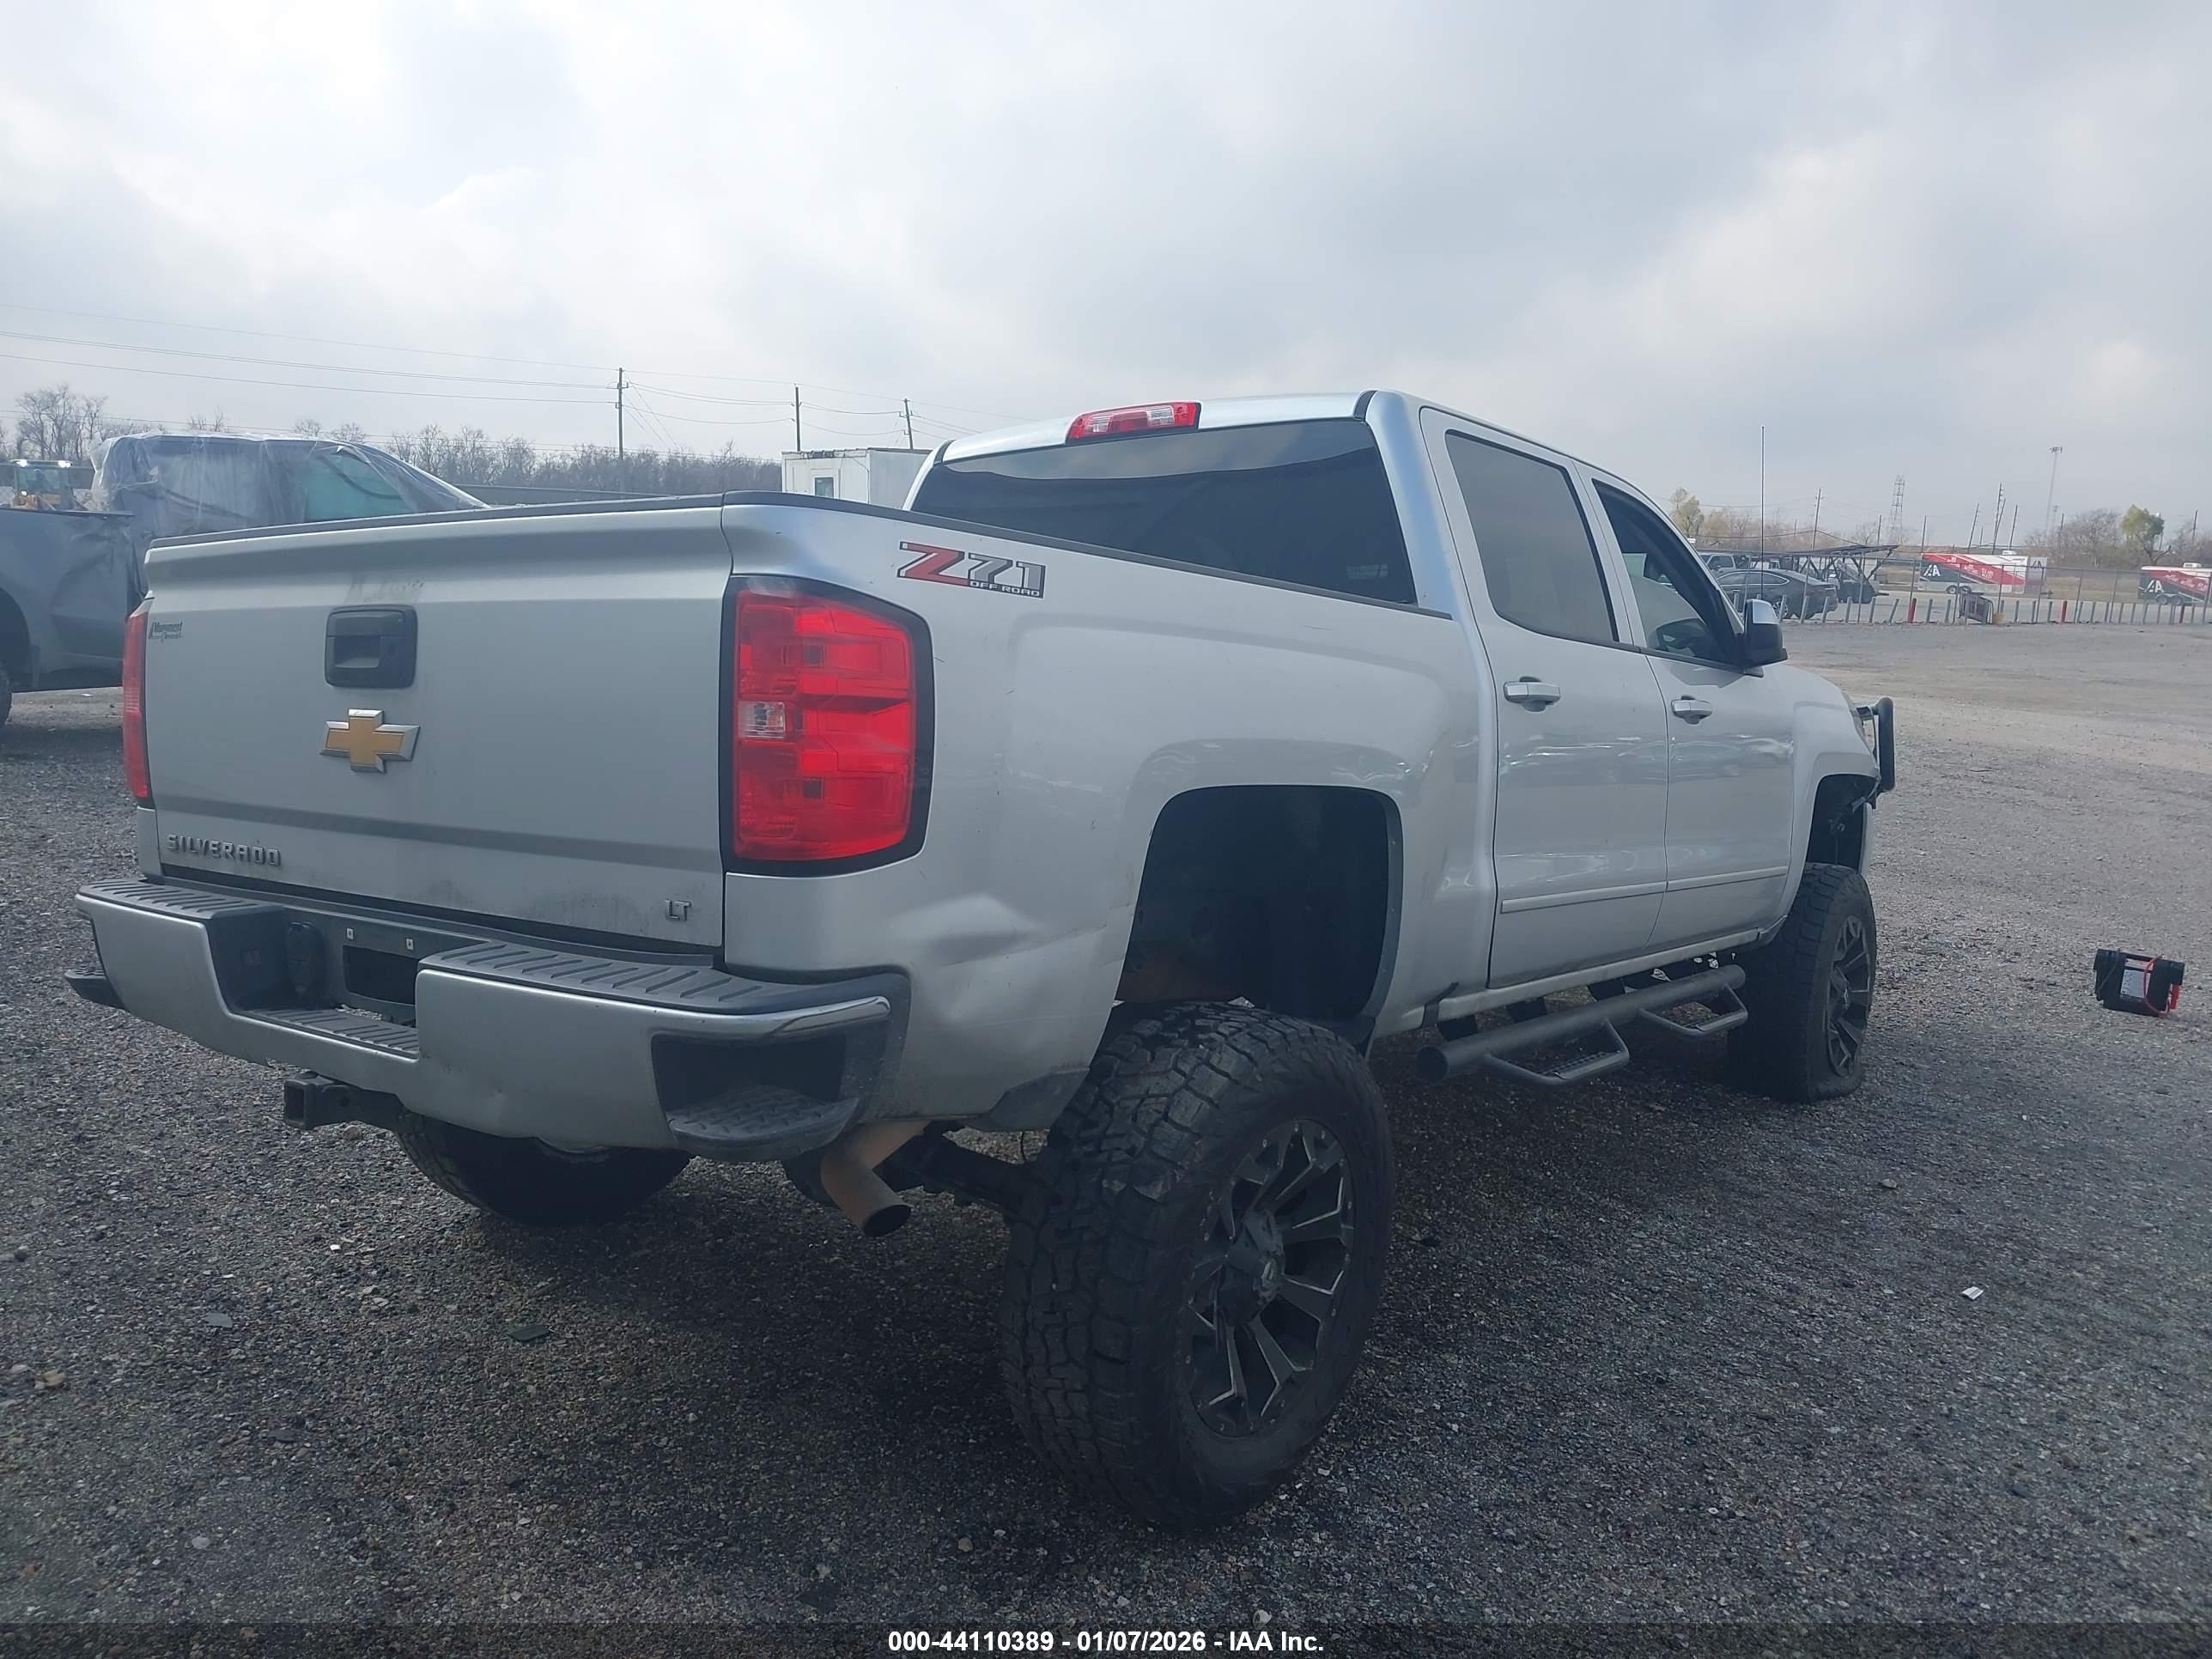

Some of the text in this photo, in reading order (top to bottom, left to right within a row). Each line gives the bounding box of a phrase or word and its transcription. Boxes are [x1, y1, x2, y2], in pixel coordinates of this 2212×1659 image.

[897, 541, 1047, 592] Z71
[969, 580, 1041, 597] OFF ROAD
[167, 834, 282, 866] SILVERADO
[665, 899, 691, 921] LT
